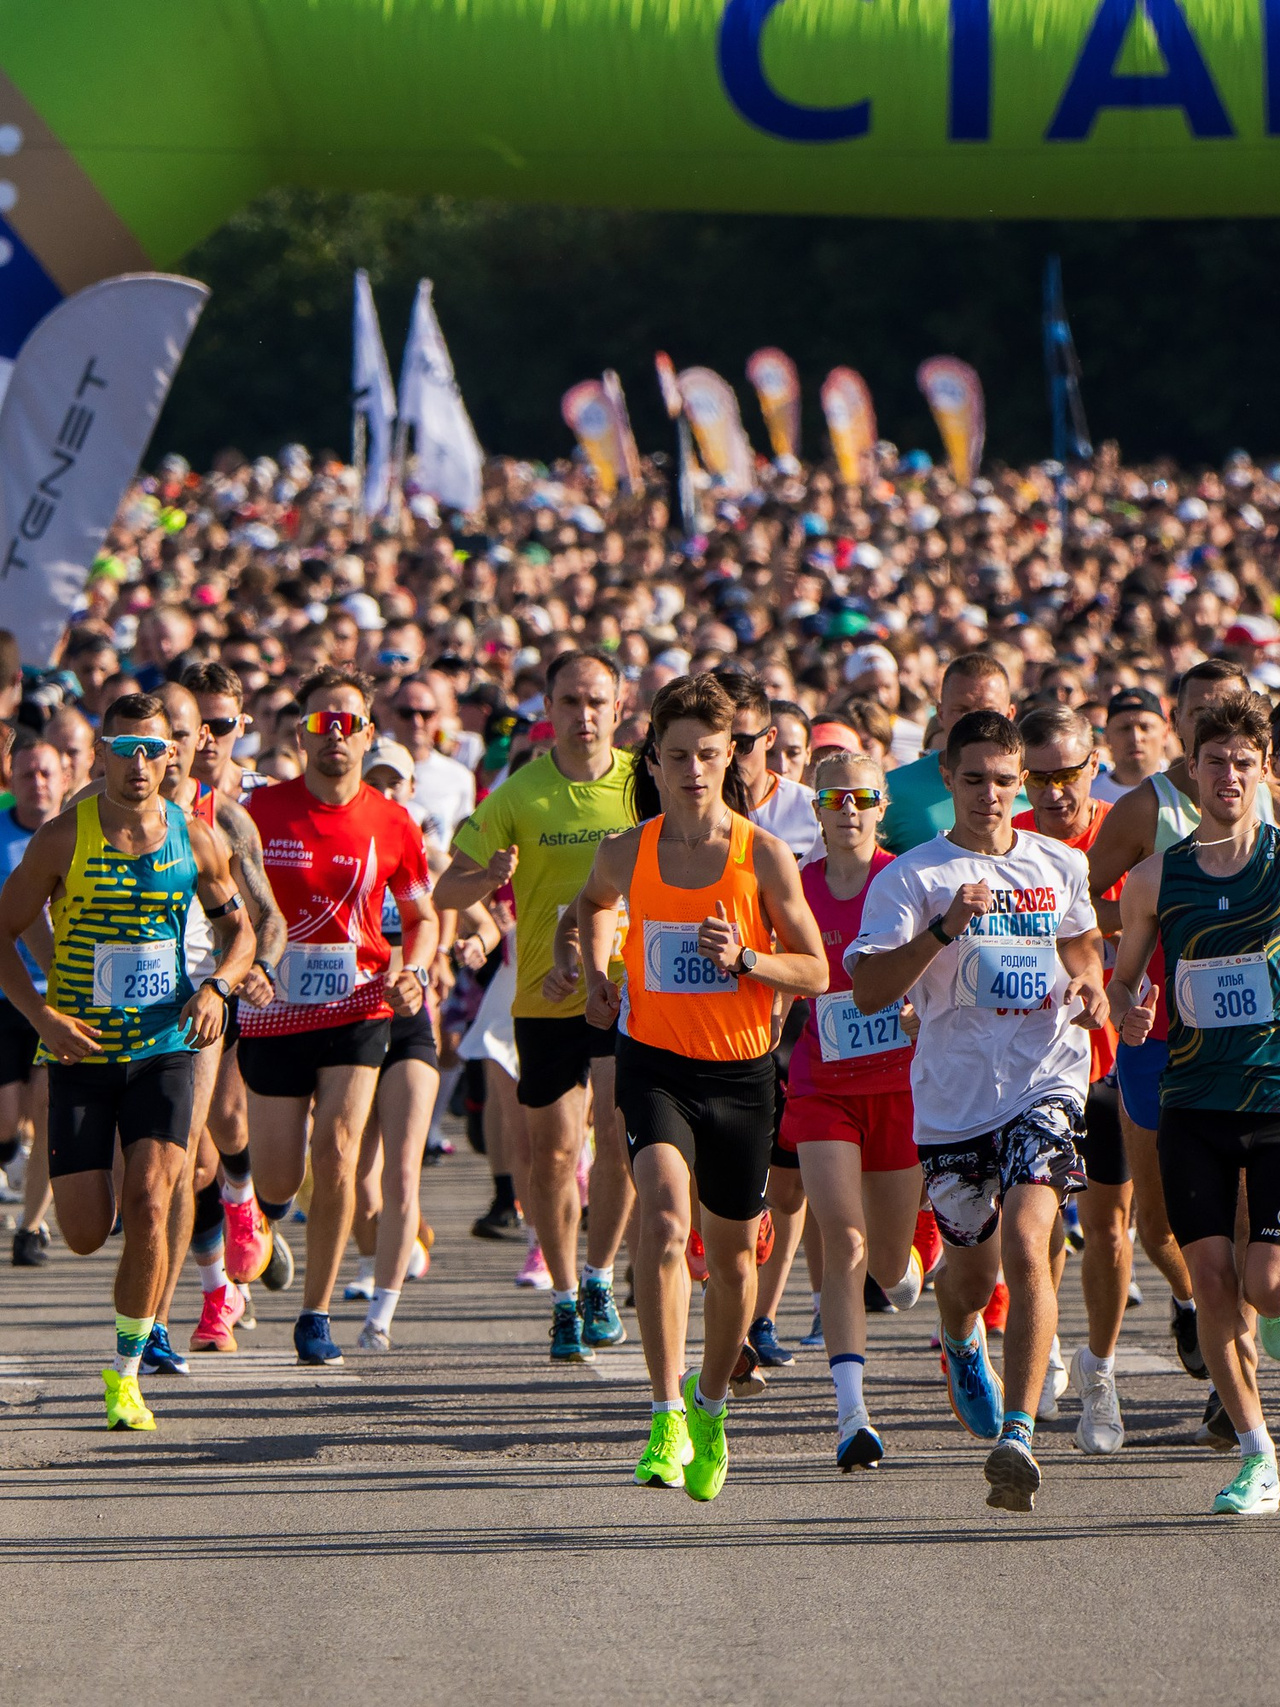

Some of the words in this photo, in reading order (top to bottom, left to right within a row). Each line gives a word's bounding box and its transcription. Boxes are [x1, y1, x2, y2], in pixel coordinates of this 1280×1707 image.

[1, 354, 109, 580] TENET
[269, 838, 304, 850] АРЕНА
[332, 854, 354, 866] 42,2
[312, 894, 329, 905] 21,1
[987, 887, 1056, 914] БЕГ2025
[135, 957, 161, 972] ДЕНИС
[306, 957, 344, 970] АЛЕКСЕЙ
[1000, 955, 1037, 969] РОДИОН
[124, 971, 170, 999] 2335
[300, 973, 349, 997] 2790
[990, 971, 1047, 1000] 4065
[1217, 973, 1244, 988] ИЛЬЯ
[1213, 988, 1257, 1019] 308
[848, 1014, 899, 1049] 2127
